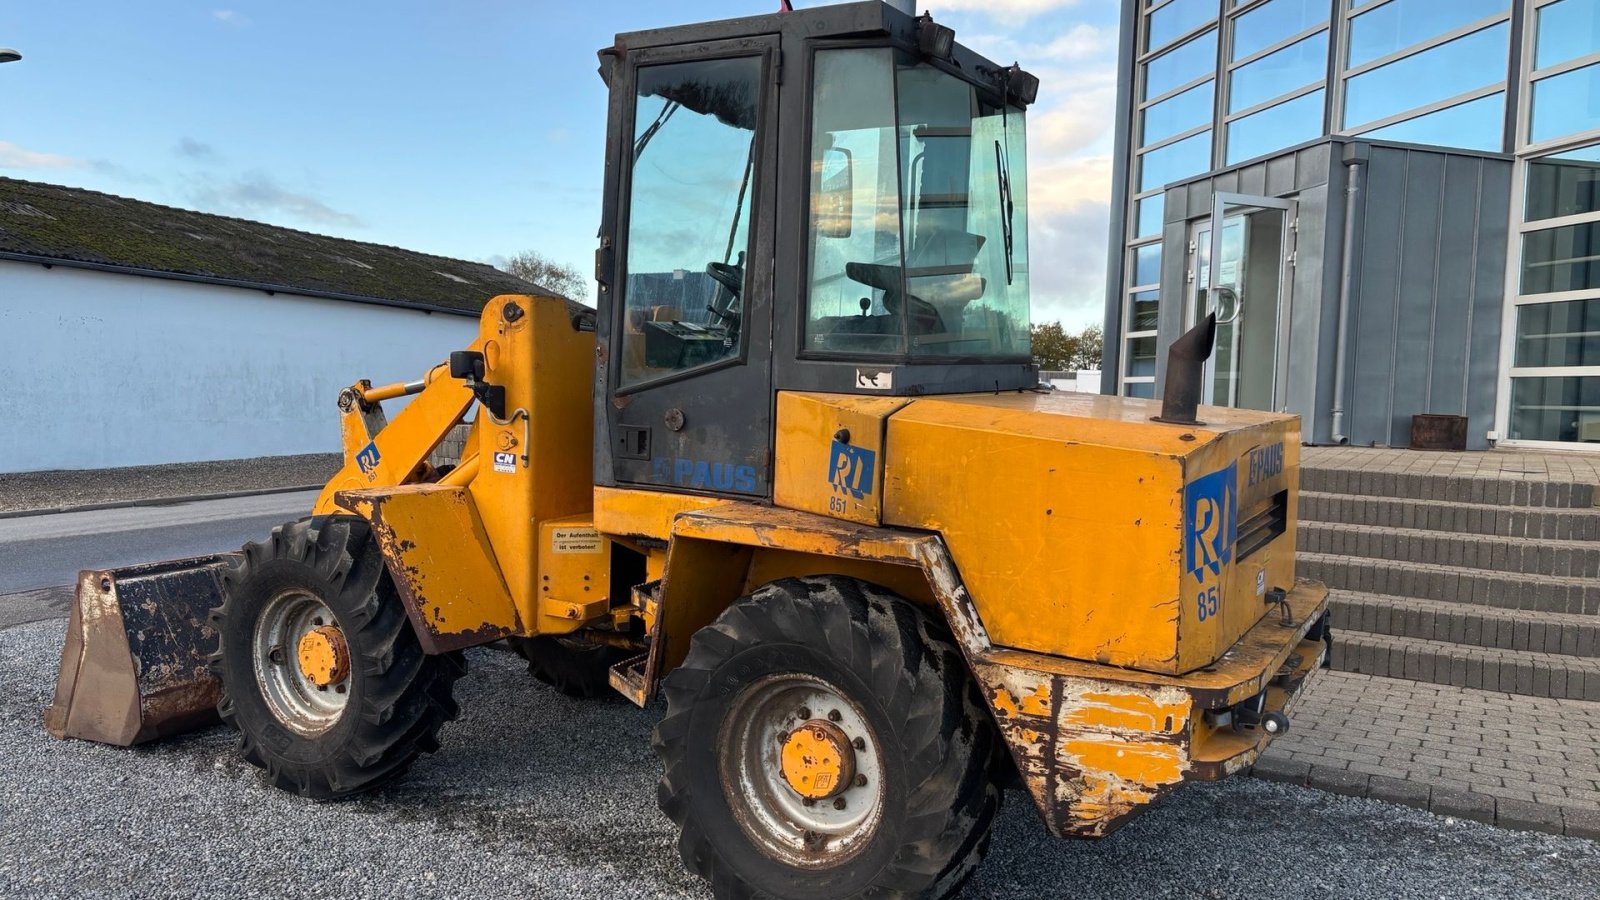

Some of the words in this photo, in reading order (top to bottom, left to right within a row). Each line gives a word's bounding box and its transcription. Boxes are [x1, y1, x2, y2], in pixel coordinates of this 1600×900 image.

[495, 452, 515, 465] CN
[674, 458, 756, 492] PAUS
[829, 495, 848, 514] 851
[1197, 582, 1221, 622] 851
